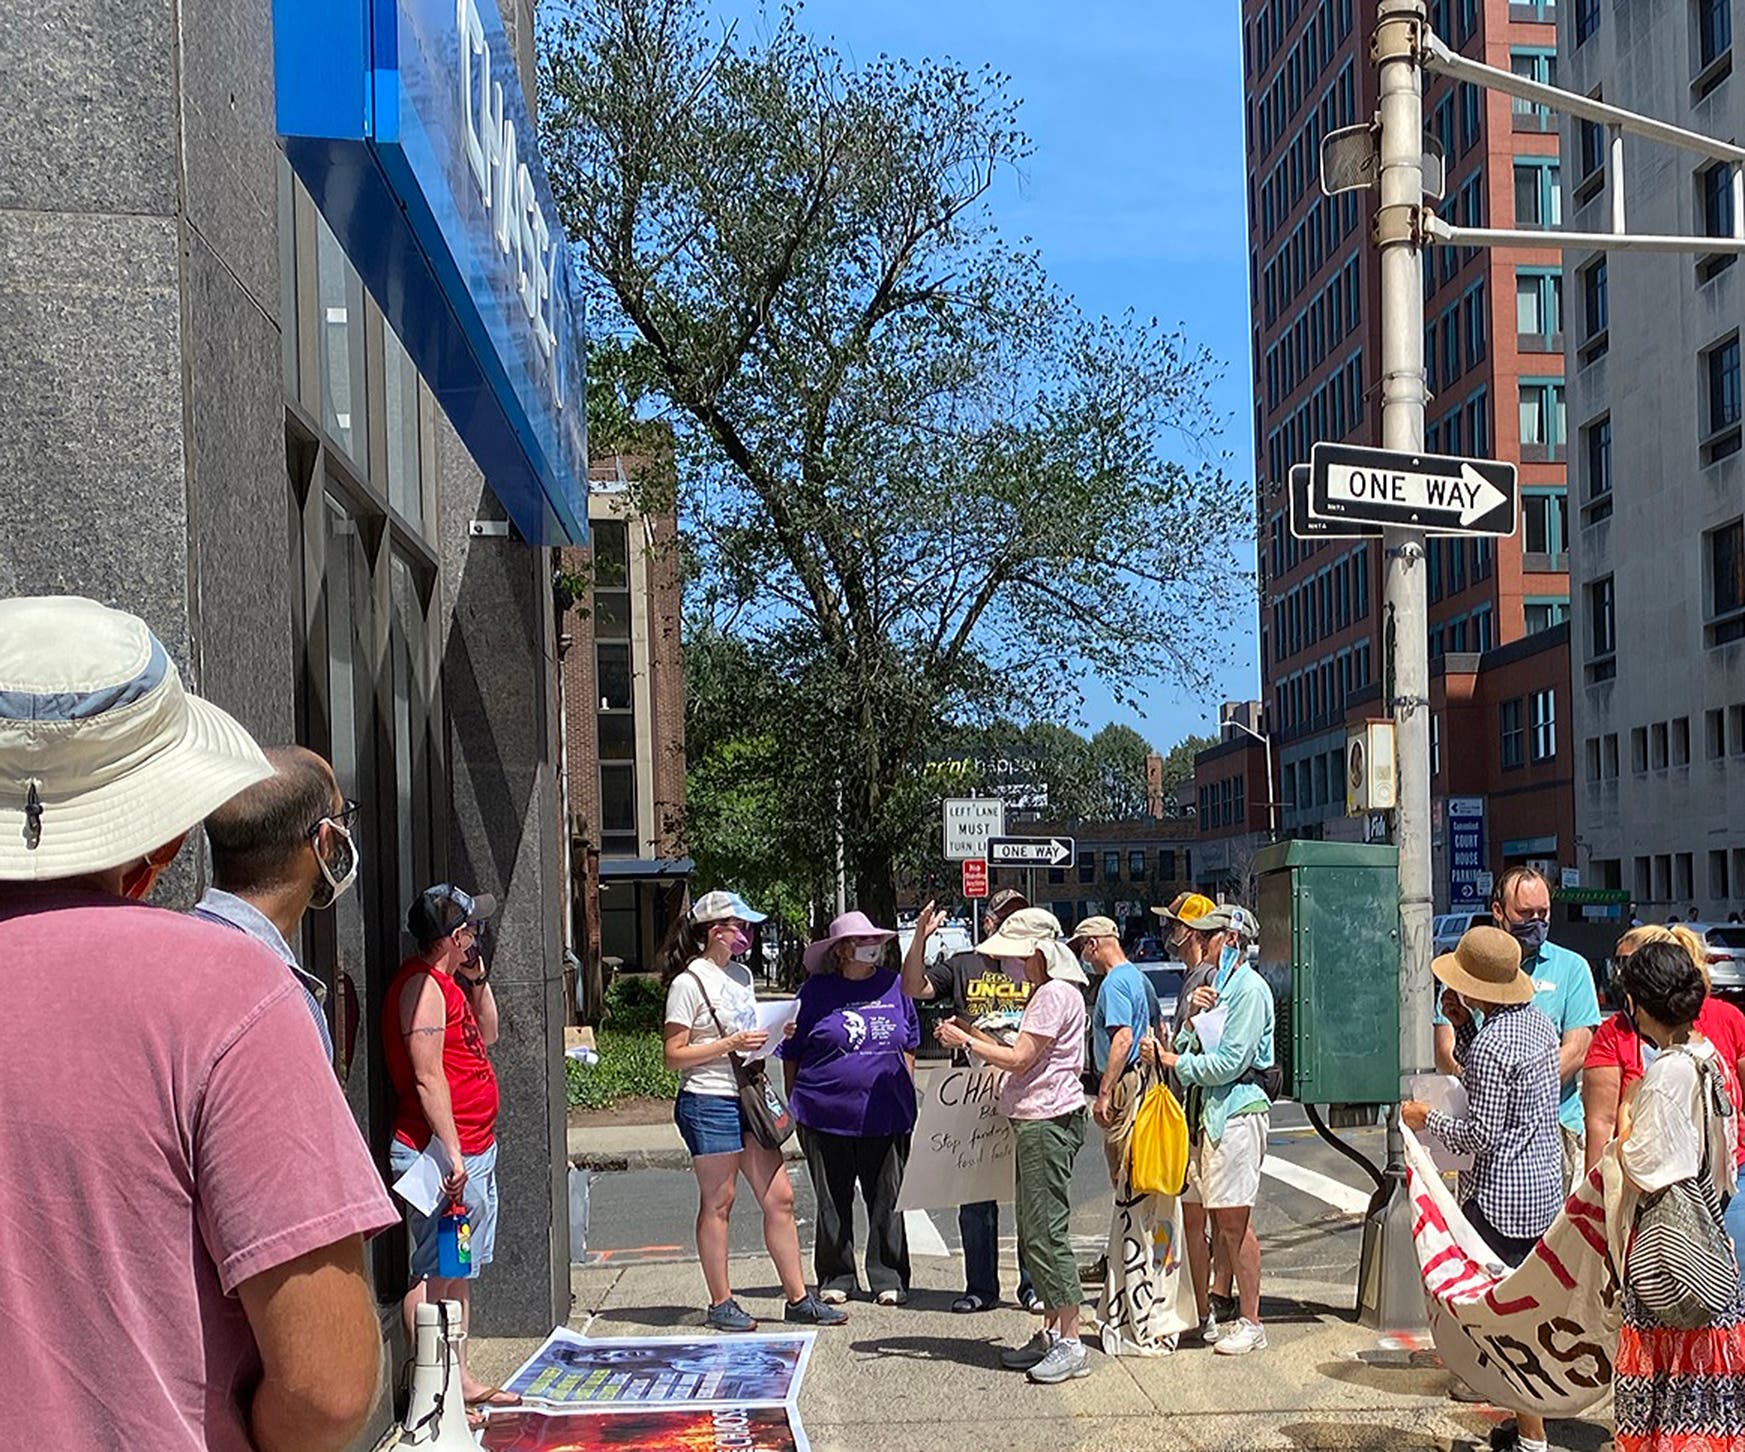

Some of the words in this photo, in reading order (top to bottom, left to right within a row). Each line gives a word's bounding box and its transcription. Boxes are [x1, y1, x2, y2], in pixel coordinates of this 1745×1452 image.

[456, 0, 550, 357] CHASE
[1350, 471, 1406, 502] ONE
[1426, 479, 1481, 509] WAY
[950, 807, 971, 817] LEFT
[976, 807, 999, 817] LANE
[958, 823, 990, 836] MUST
[950, 841, 972, 852] TURN
[1455, 834, 1478, 848] COURT
[1002, 845, 1028, 857] ONE
[1035, 846, 1060, 858] WAY
[1455, 852, 1478, 865] HOUSE
[930, 1133, 960, 1154] Stop
